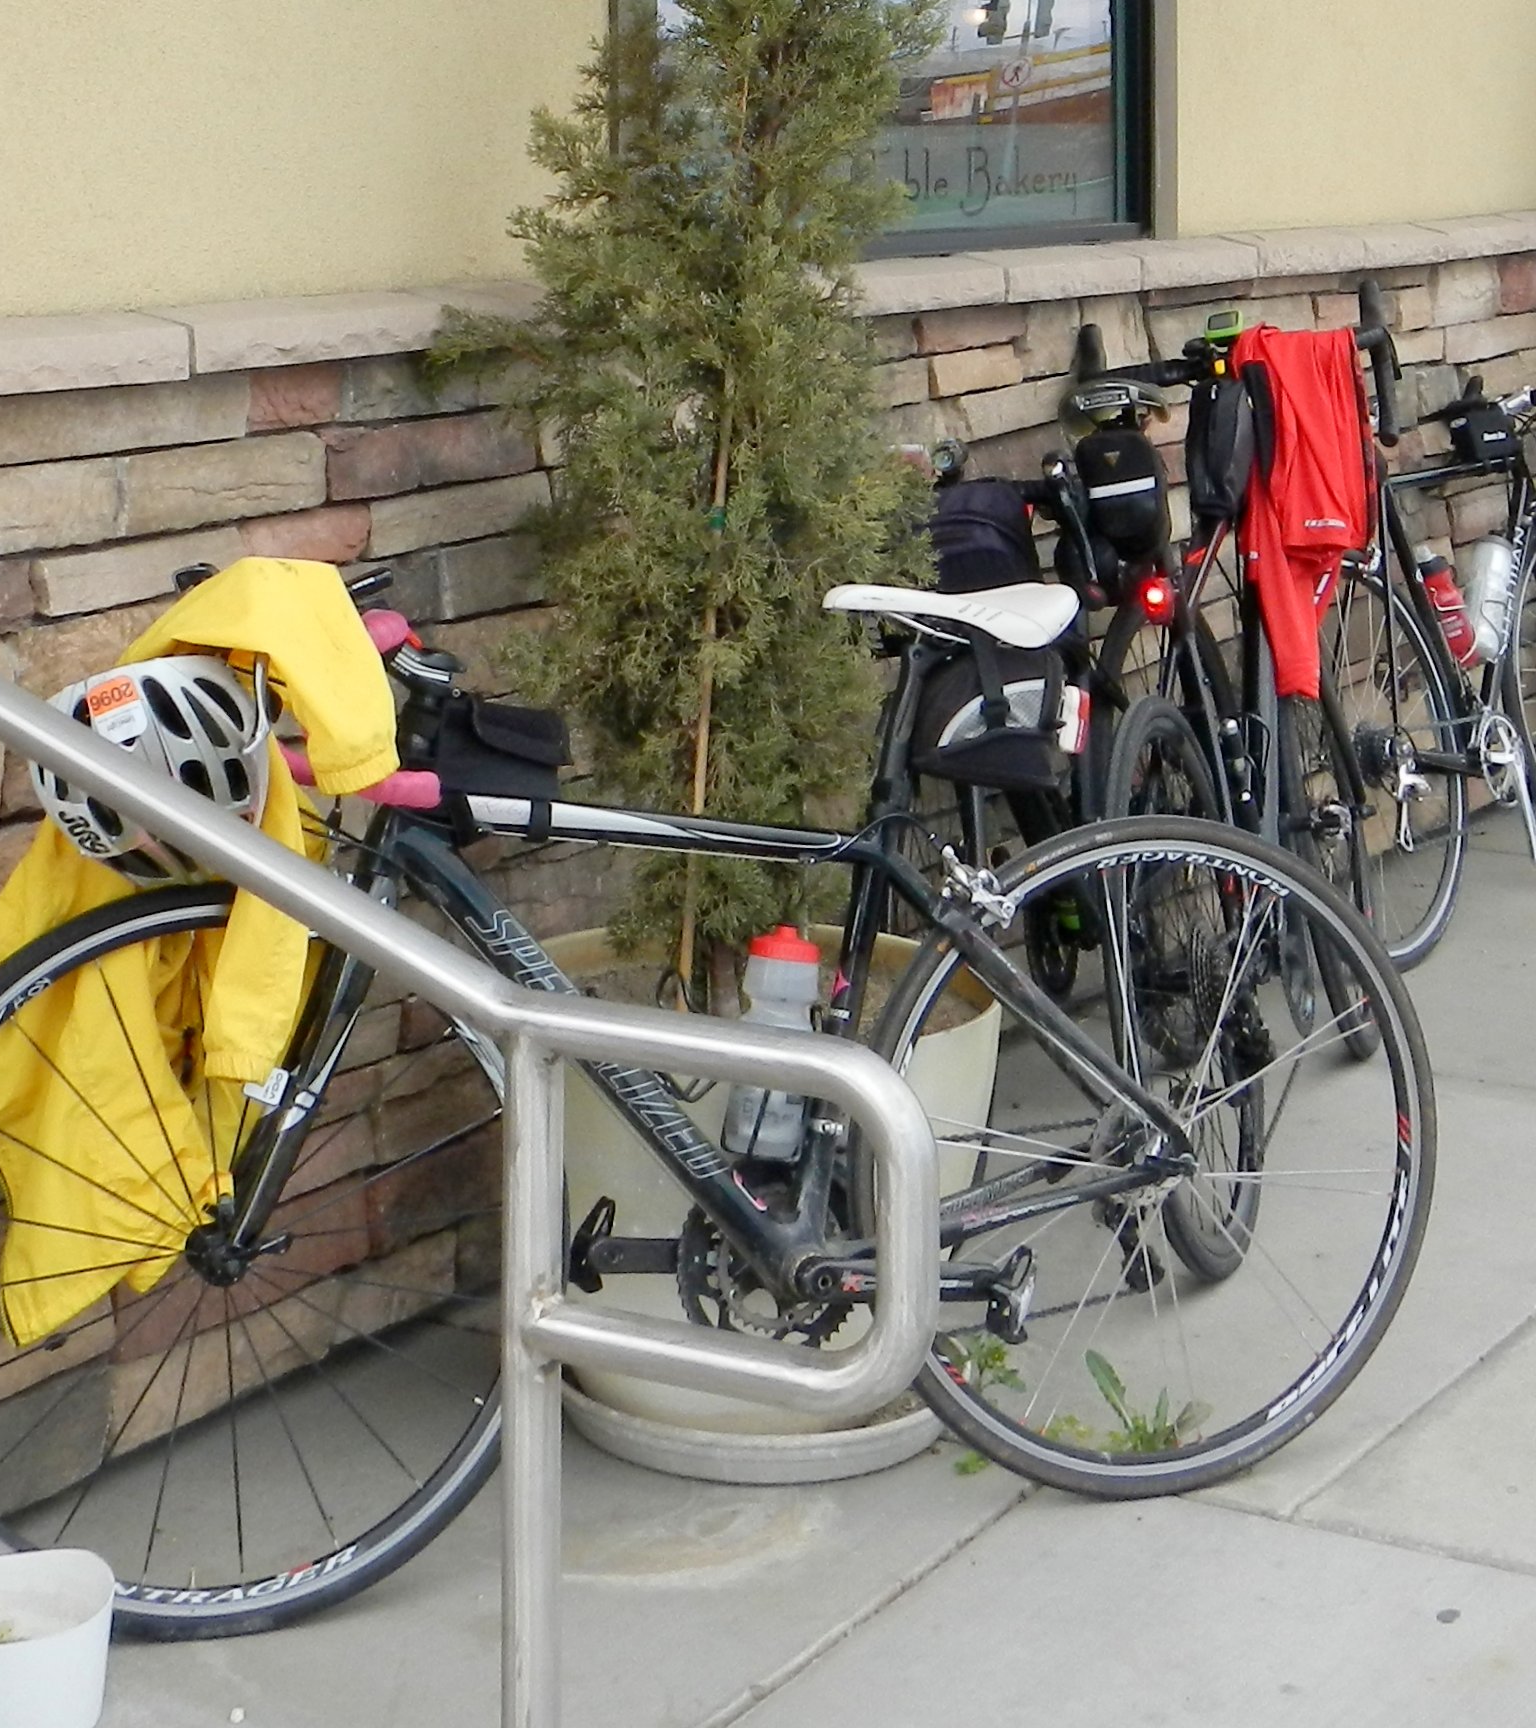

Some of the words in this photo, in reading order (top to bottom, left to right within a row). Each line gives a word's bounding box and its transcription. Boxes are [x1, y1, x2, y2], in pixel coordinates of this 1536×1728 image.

[959, 145, 1078, 217] Bakery
[89, 681, 134, 712] 2096
[114, 1542, 359, 1604] NTRAGER
